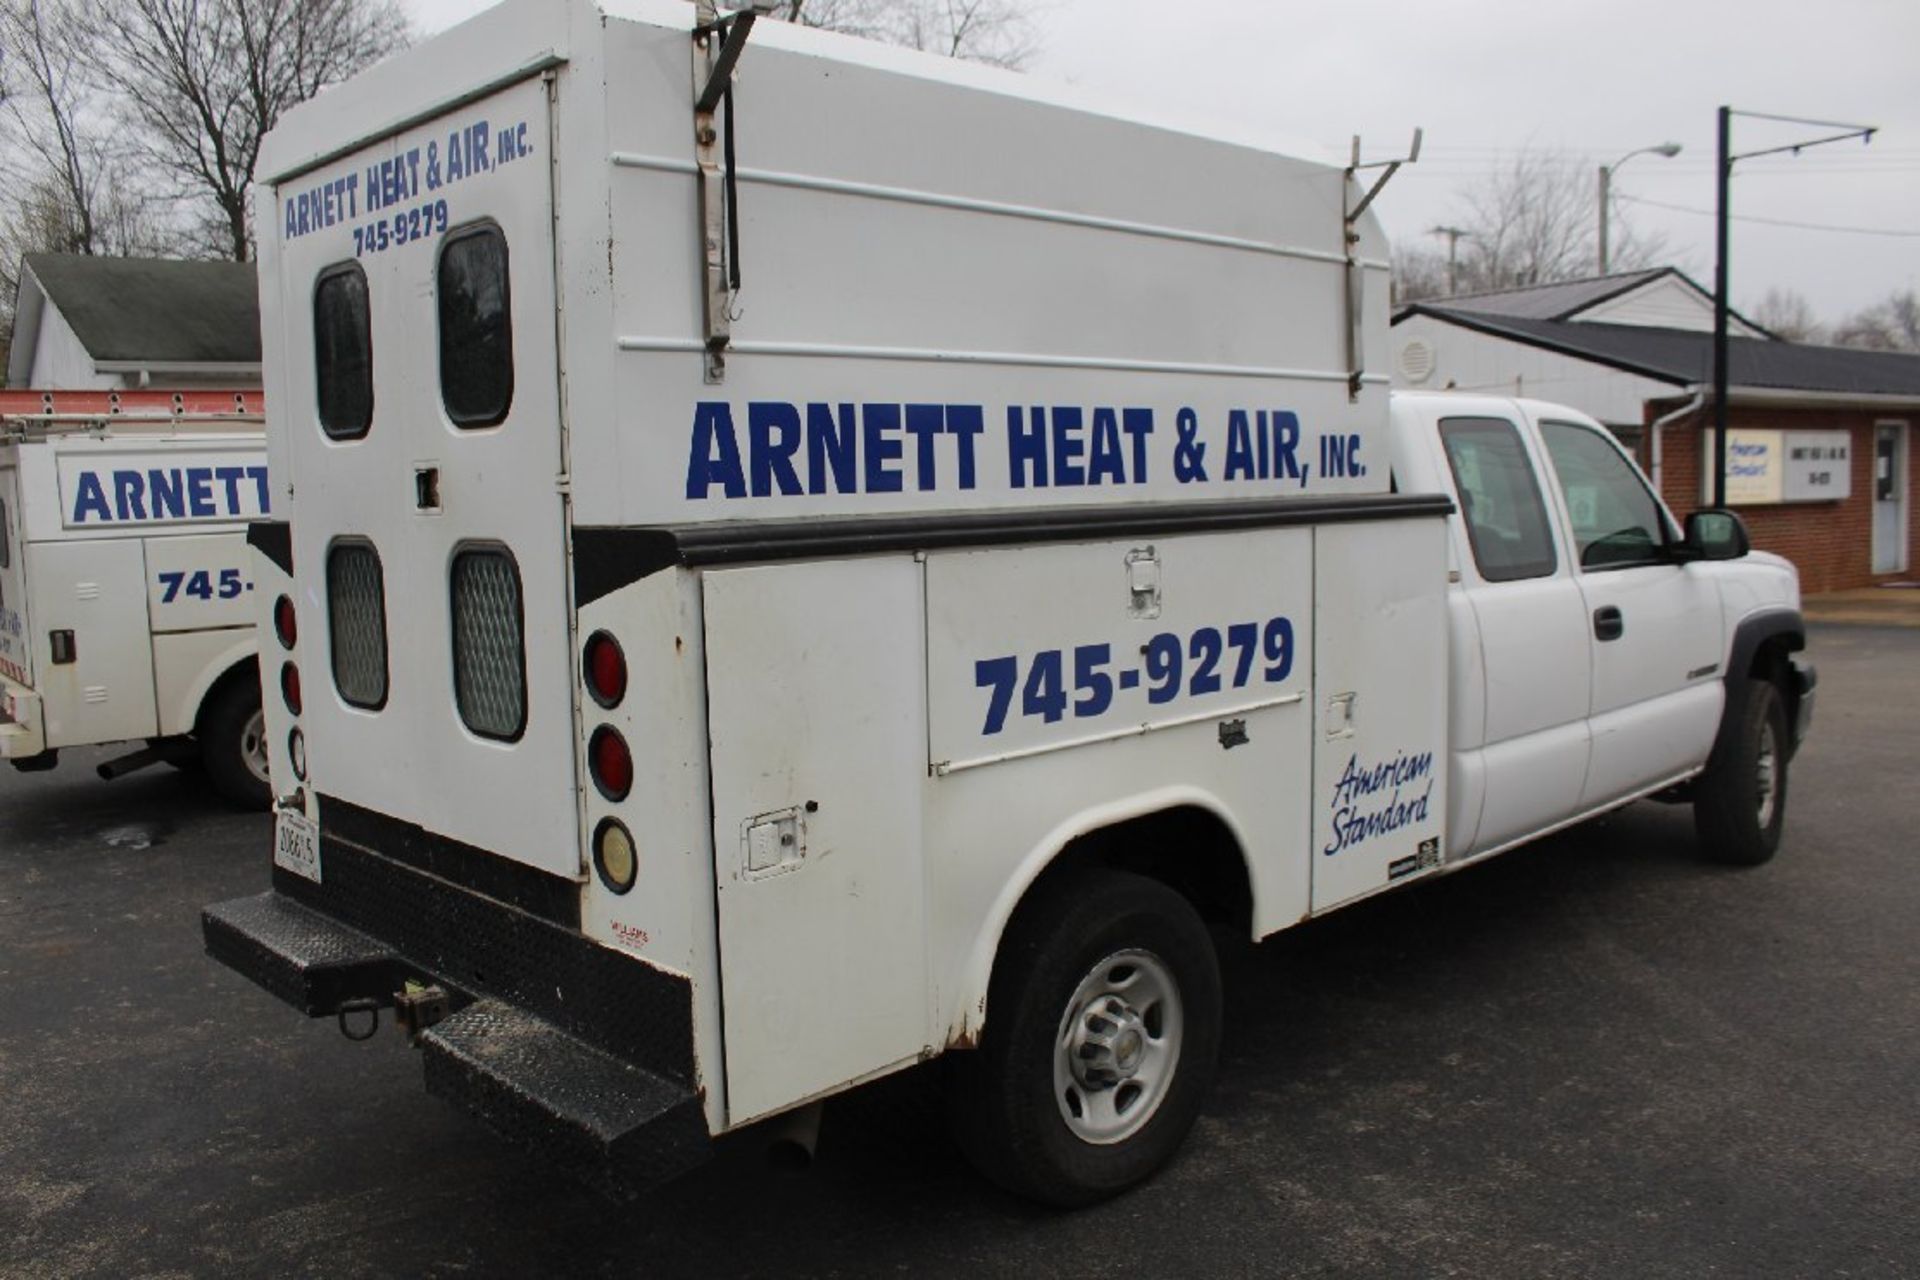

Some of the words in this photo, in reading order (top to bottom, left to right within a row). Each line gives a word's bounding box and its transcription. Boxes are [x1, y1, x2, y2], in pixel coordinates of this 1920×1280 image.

[285, 173, 358, 240] ARNETT
[366, 148, 421, 213] HEAT
[426, 141, 443, 191] &
[446, 119, 496, 184] AIR,
[497, 121, 534, 165] INC.
[352, 199, 449, 258] 745-9279
[686, 401, 984, 500] ARNETT
[1007, 405, 1154, 489] HEAT
[1173, 406, 1208, 484] &
[1223, 409, 1309, 488] AIR,
[1319, 434, 1366, 478] INC.
[975, 616, 1294, 736] 745-9279
[1324, 778, 1434, 856] Standard
[1331, 749, 1433, 807] American
